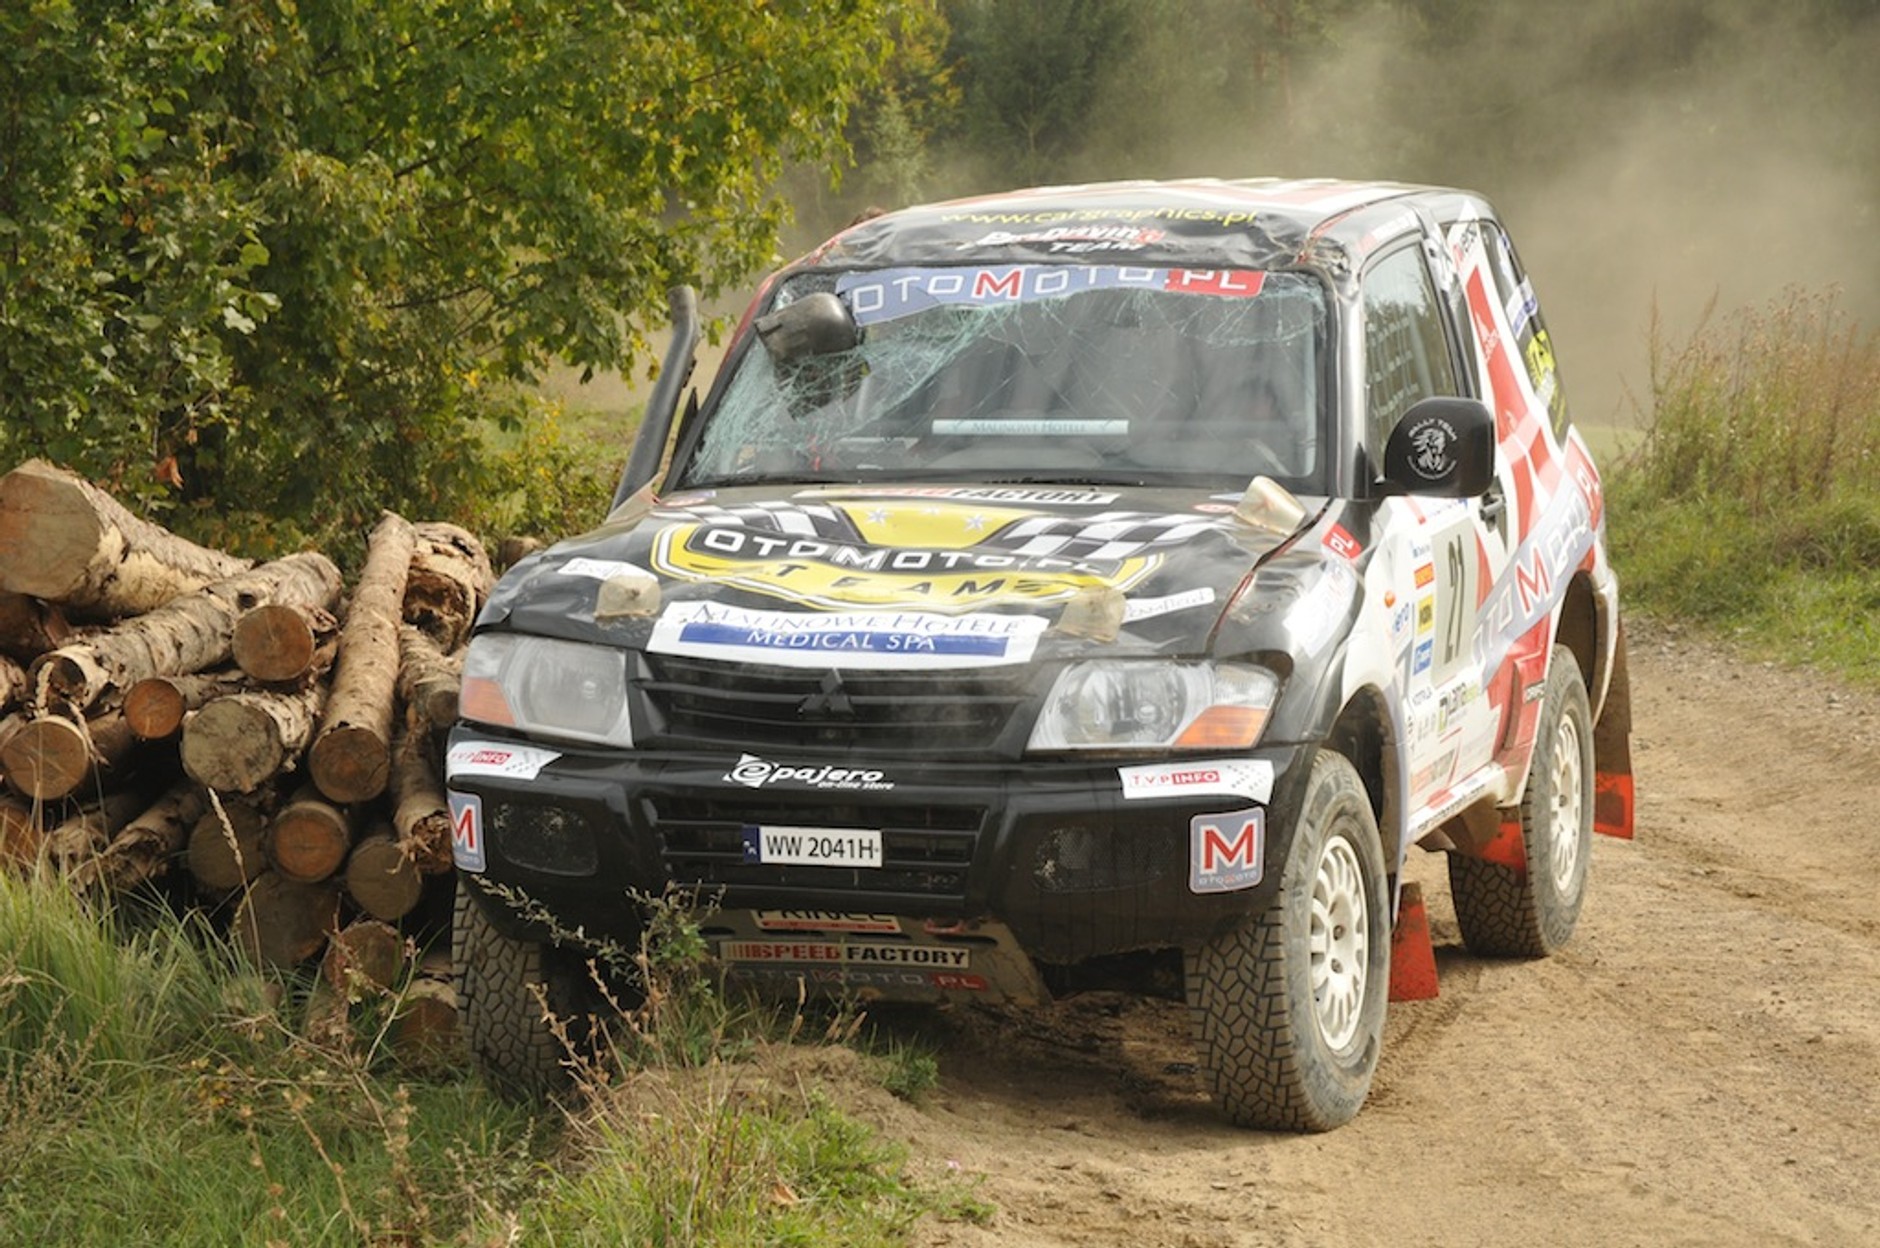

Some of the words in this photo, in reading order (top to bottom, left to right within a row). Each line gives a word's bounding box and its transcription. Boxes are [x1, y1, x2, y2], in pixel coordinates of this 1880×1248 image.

[940, 207, 1256, 226] www.cargraphics.pl
[776, 563, 1058, 598] TEAMS
[1444, 524, 1465, 665] 21
[689, 603, 878, 632] MALINOWE
[886, 613, 1025, 635] HOTELE
[746, 628, 875, 650] MEDICAL
[886, 633, 936, 652] SPA
[862, 781, 895, 791] store
[1131, 774, 1170, 785] TVP
[1174, 771, 1218, 785] INFO
[766, 835, 803, 857] WW
[807, 836, 874, 860] 2041H
[1201, 818, 1258, 875] M
[757, 943, 843, 961] SPEED
[846, 946, 968, 965] FACTORY
